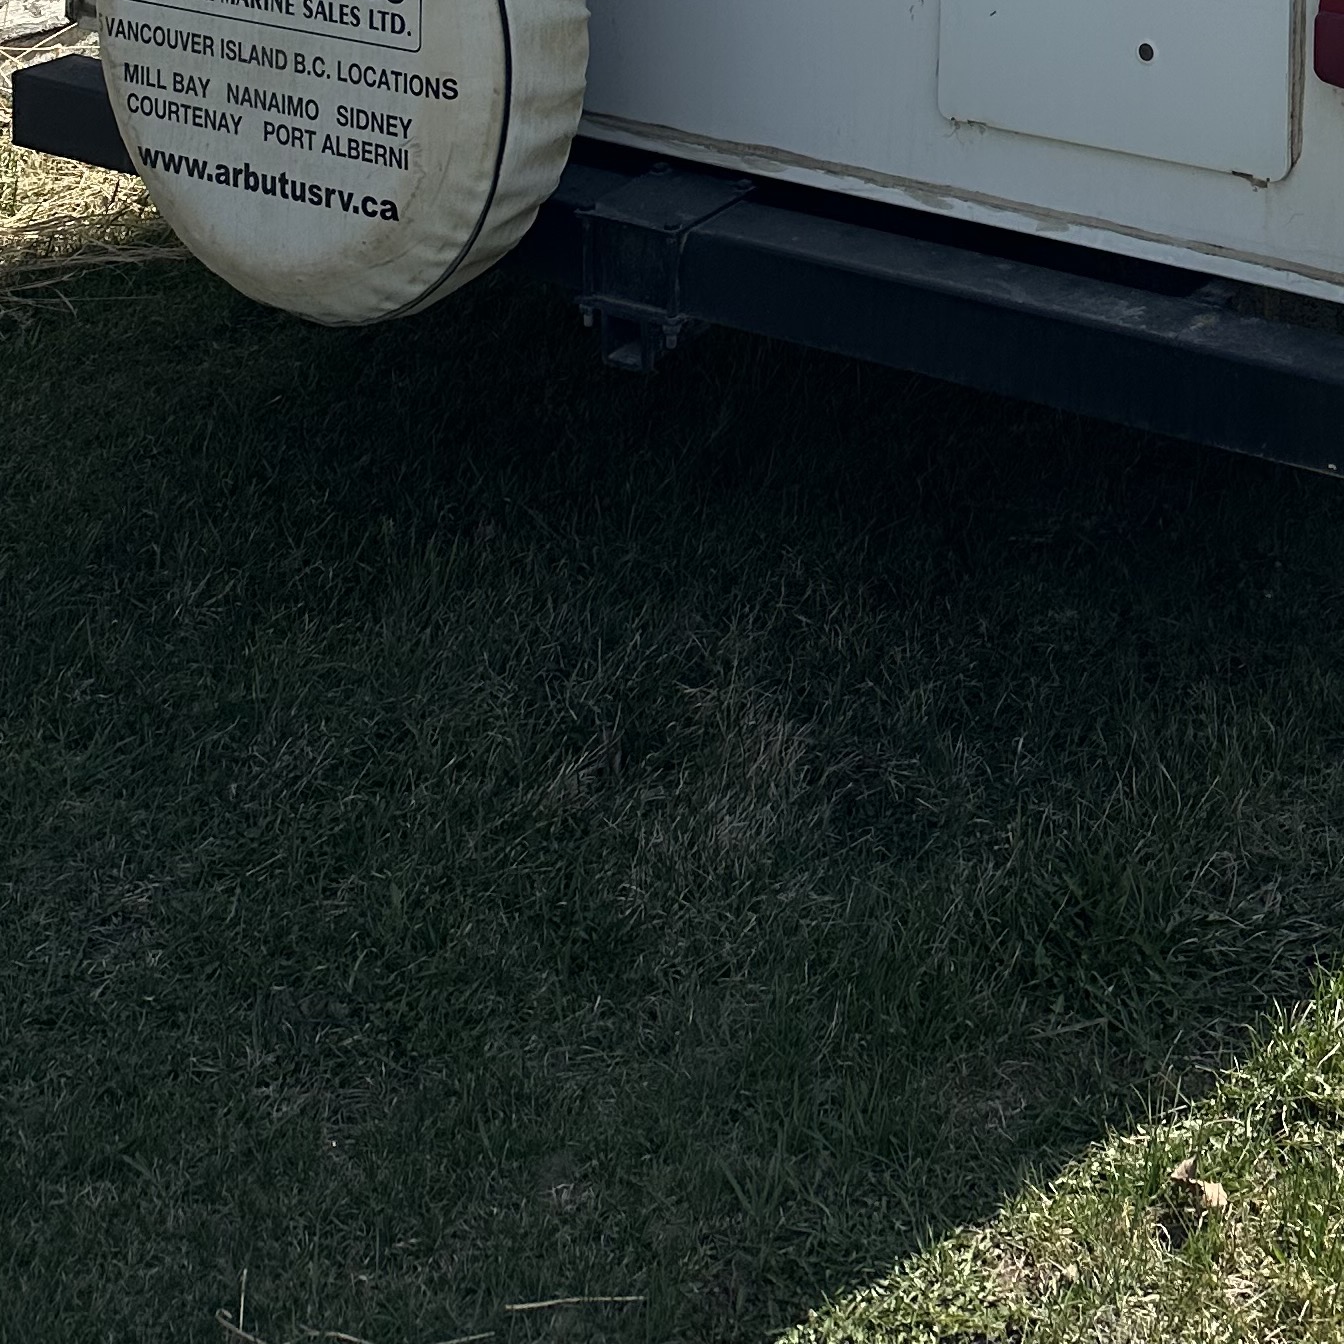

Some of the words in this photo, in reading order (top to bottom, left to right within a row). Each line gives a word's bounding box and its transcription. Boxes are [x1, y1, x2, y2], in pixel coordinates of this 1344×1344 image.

[105, 16, 215, 58] VANCOUVER
[220, 38, 288, 71] ISLAND
[293, 52, 331, 79] B.C.
[336, 60, 460, 101] LOCATIONS
[368, 9, 412, 37] LTD.
[123, 62, 167, 91] MILL
[172, 72, 211, 98] BAY
[226, 83, 320, 121] NANAIMO
[335, 105, 413, 140] SIDNEY
[126, 92, 243, 136] COURTENAY
[263, 121, 318, 152] PORT
[321, 134, 410, 171] ALBERNI
[137, 145, 400, 222] www.arbutusrv.ca
